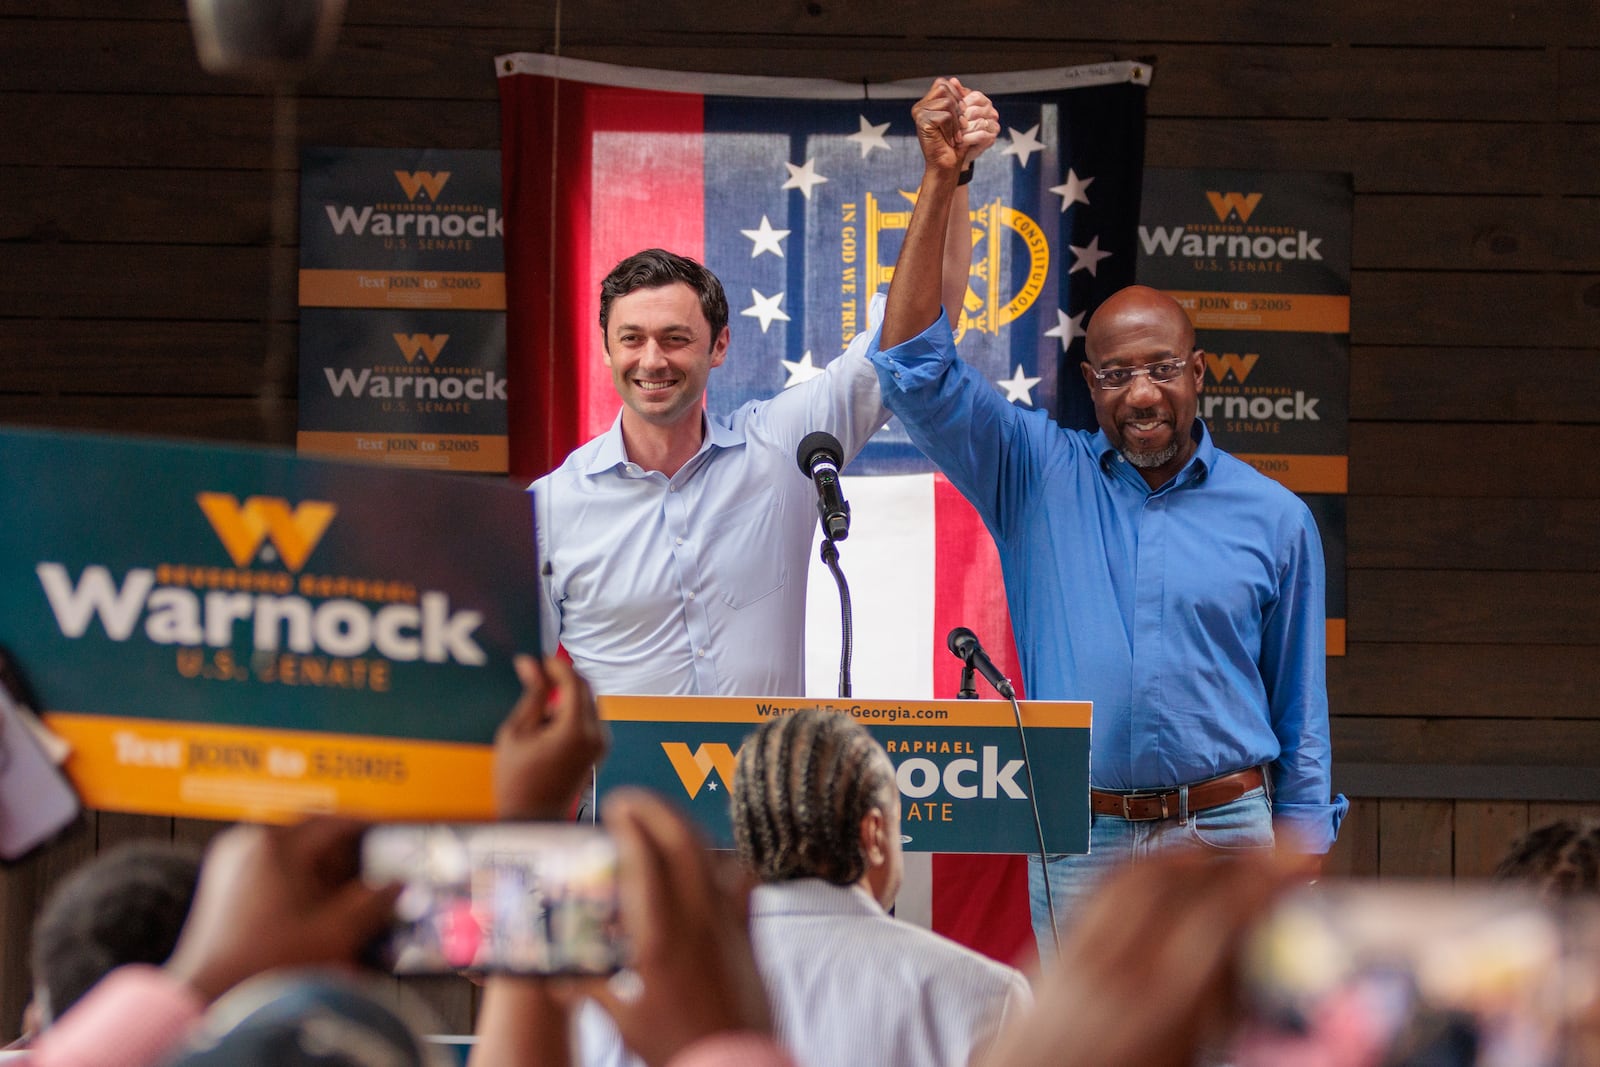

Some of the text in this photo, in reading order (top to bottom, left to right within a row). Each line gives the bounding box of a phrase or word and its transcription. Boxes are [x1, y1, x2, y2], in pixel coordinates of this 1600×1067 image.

[325, 205, 504, 237] Warnock
[418, 240, 473, 251] SENATE
[1138, 225, 1323, 260] Warnock
[841, 203, 857, 350] IN GOD WE TRUS
[1008, 216, 1046, 315] CONSTITUTION
[1194, 261, 1283, 273] U.S. SENATE
[358, 275, 481, 289] Text JOIN to 52005
[1199, 298, 1230, 310] JOIN
[1233, 300, 1248, 310] to
[1250, 300, 1292, 311] 52005
[323, 367, 508, 400] Warnock
[416, 402, 471, 414] SENATE
[1197, 391, 1320, 421] rnock
[1227, 422, 1280, 433] SENATE
[356, 438, 480, 452] Text JOIN to 52005
[37, 561, 487, 666] Warnock
[176, 648, 248, 681] U.S.
[112, 731, 183, 768] Text
[187, 742, 261, 772] JOIN
[266, 747, 307, 778] to
[887, 741, 974, 754] RAPHAEL
[898, 803, 953, 821] ATE
